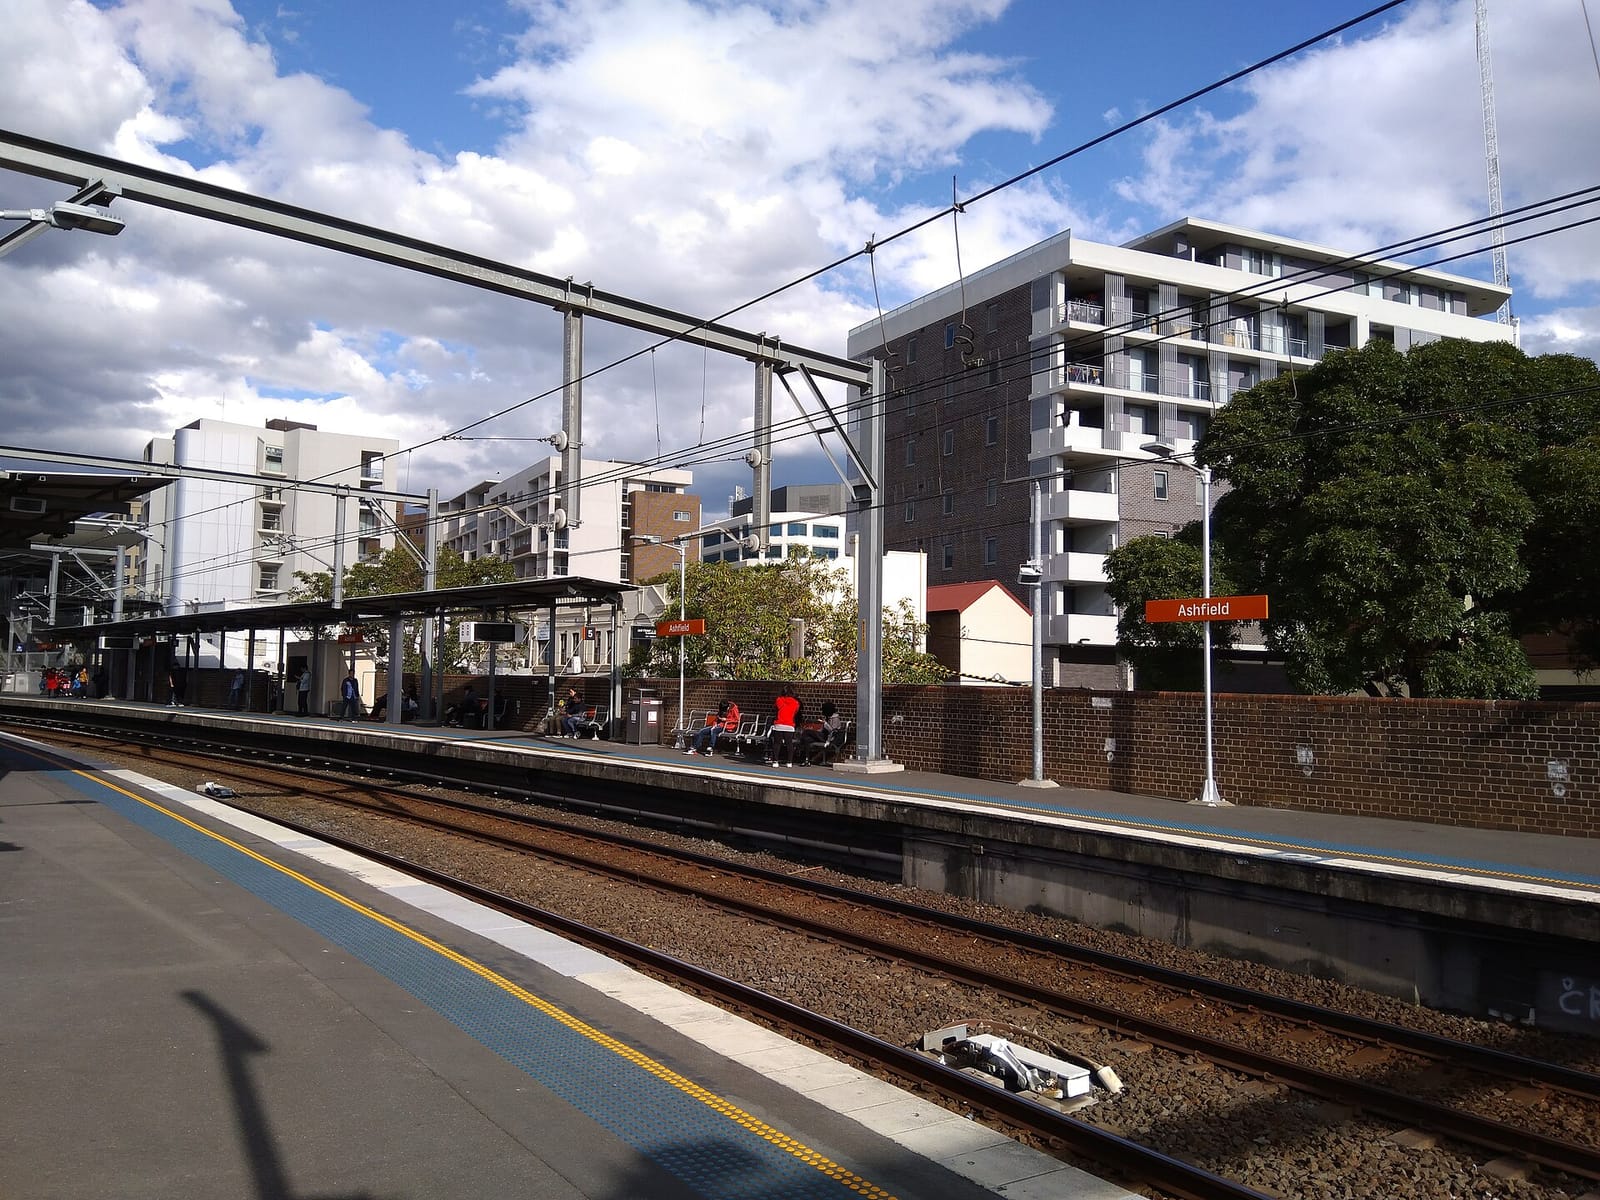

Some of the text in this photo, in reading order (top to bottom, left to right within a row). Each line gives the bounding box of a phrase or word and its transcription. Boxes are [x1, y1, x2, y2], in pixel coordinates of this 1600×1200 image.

[1177, 602, 1229, 617] Ashfield
[668, 623, 690, 633] Ashfield
[587, 629, 593, 638] 5
